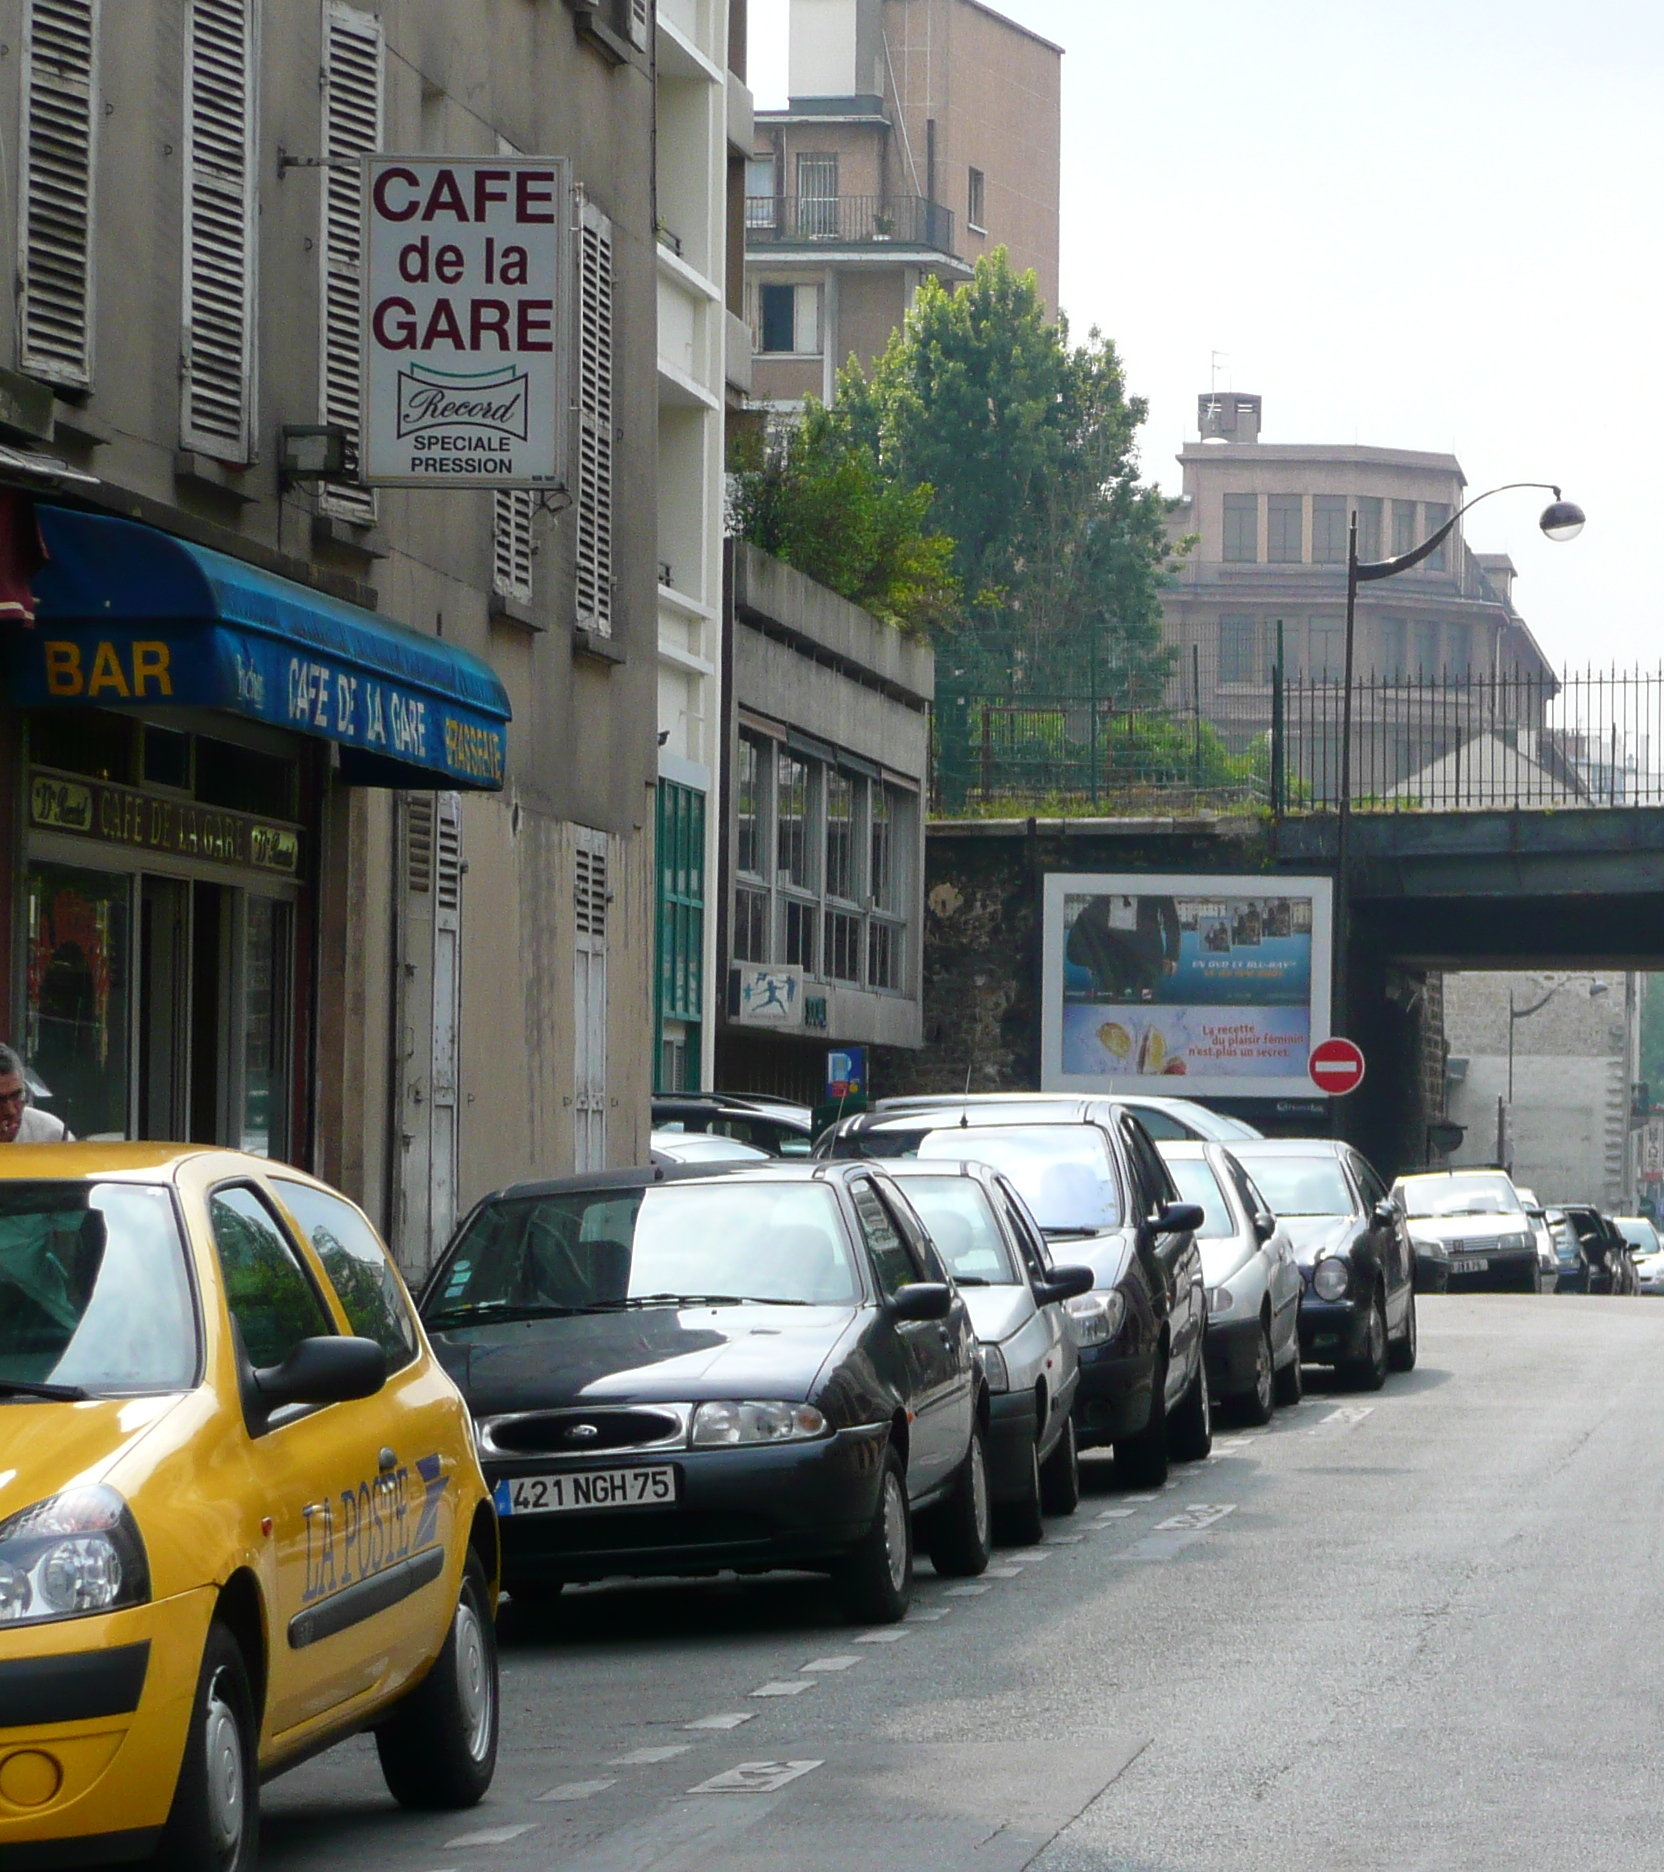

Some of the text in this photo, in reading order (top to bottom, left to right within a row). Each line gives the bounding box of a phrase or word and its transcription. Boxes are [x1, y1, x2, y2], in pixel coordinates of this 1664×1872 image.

[372, 167, 555, 224] CAFE
[399, 235, 528, 285] de la
[372, 296, 554, 353] GARE
[402, 389, 517, 424] Record
[411, 456, 513, 474] PRESSION
[413, 435, 511, 453] SPECIALE
[44, 640, 174, 697] BAR
[288, 657, 330, 727] CAFE
[337, 674, 357, 735] DE
[366, 682, 386, 744] LA
[391, 692, 426, 757] GARE
[101, 790, 143, 842] CAFE
[150, 802, 172, 847] DE
[179, 808, 198, 853] LA
[204, 815, 243, 861] GARE
[1188, 1045, 1213, 1057] n'est
[1215, 1046, 1238, 1059] plus
[1240, 1047, 1253, 1057] un
[1202, 1024, 1255, 1037] La recette
[1212, 1033, 1305, 1047] du plaisir féminin
[514, 1470, 669, 1509] 421 NGH 75
[302, 1466, 410, 1603] LA POSTE
